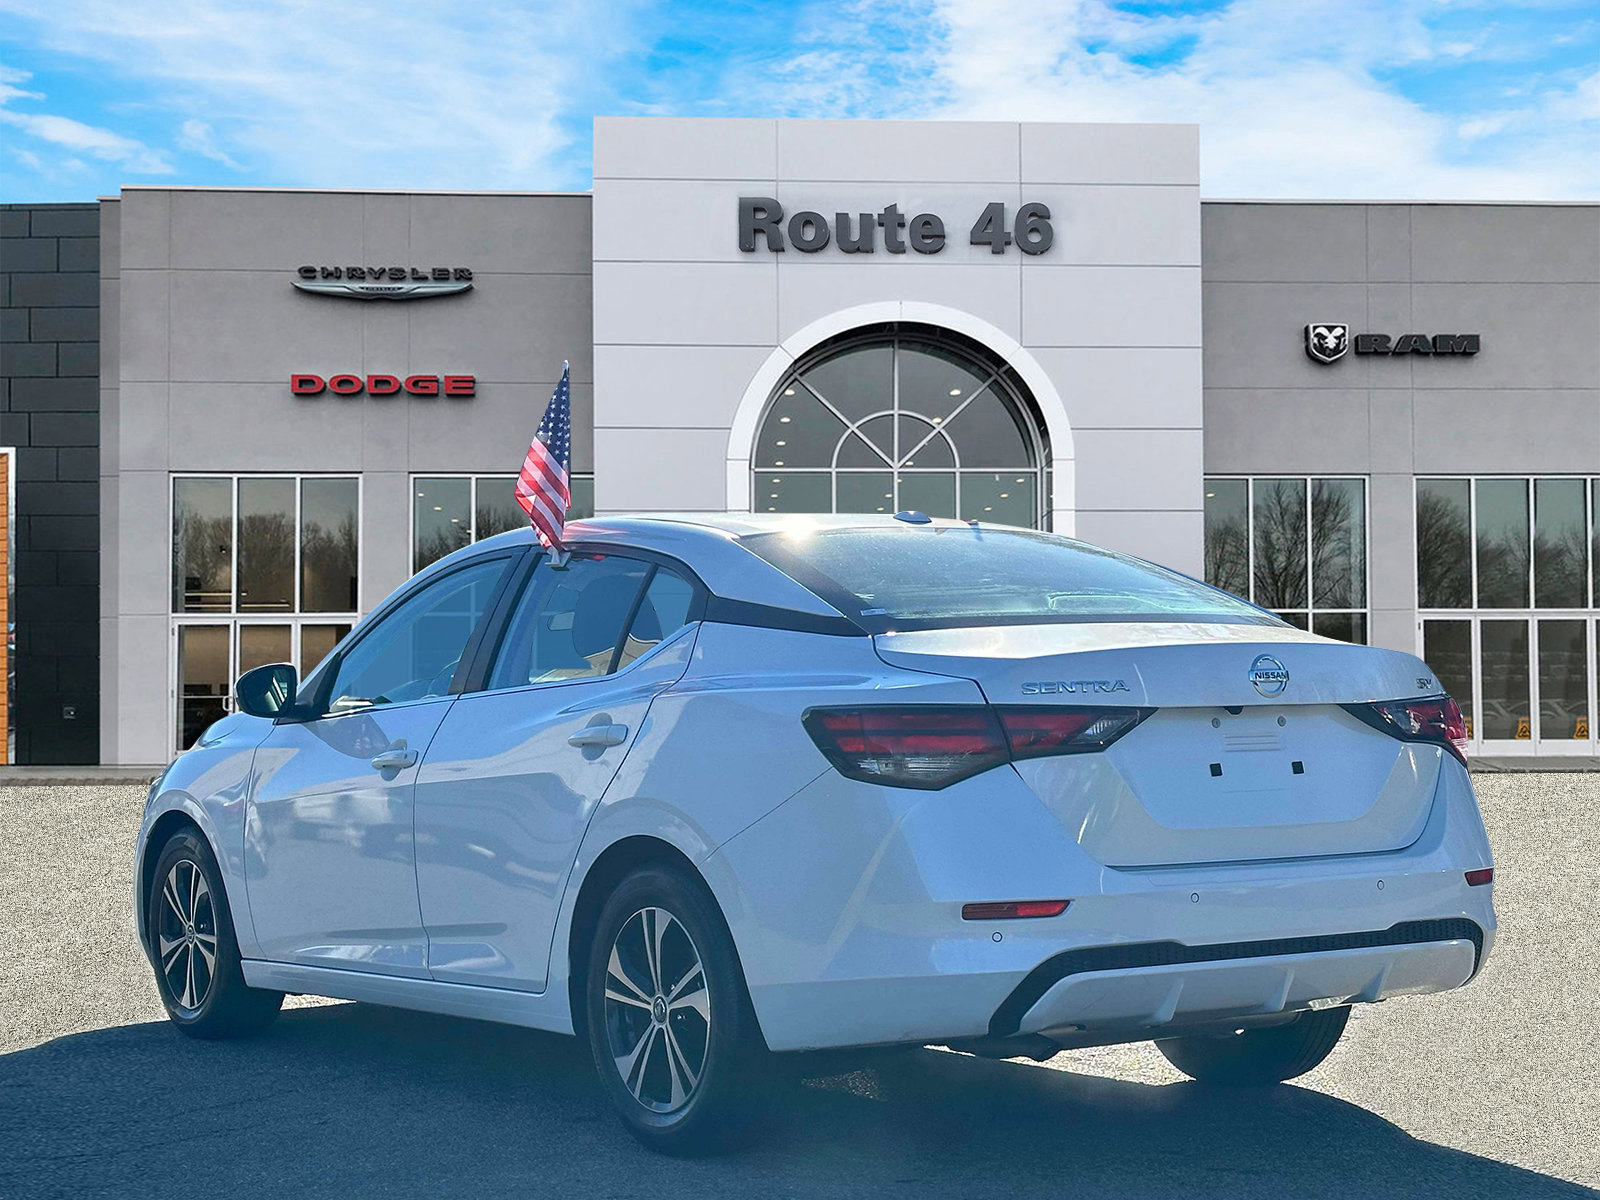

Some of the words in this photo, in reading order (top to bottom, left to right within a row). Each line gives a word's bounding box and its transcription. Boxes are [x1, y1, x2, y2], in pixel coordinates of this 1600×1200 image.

[738, 197, 946, 254] Route
[970, 202, 1054, 255] 46
[298, 266, 473, 281] CHRYSLER
[1354, 334, 1480, 355] RAM
[291, 374, 476, 397] DODGE
[1254, 671, 1287, 680] NISSAN
[1021, 680, 1130, 695] SENTRA
